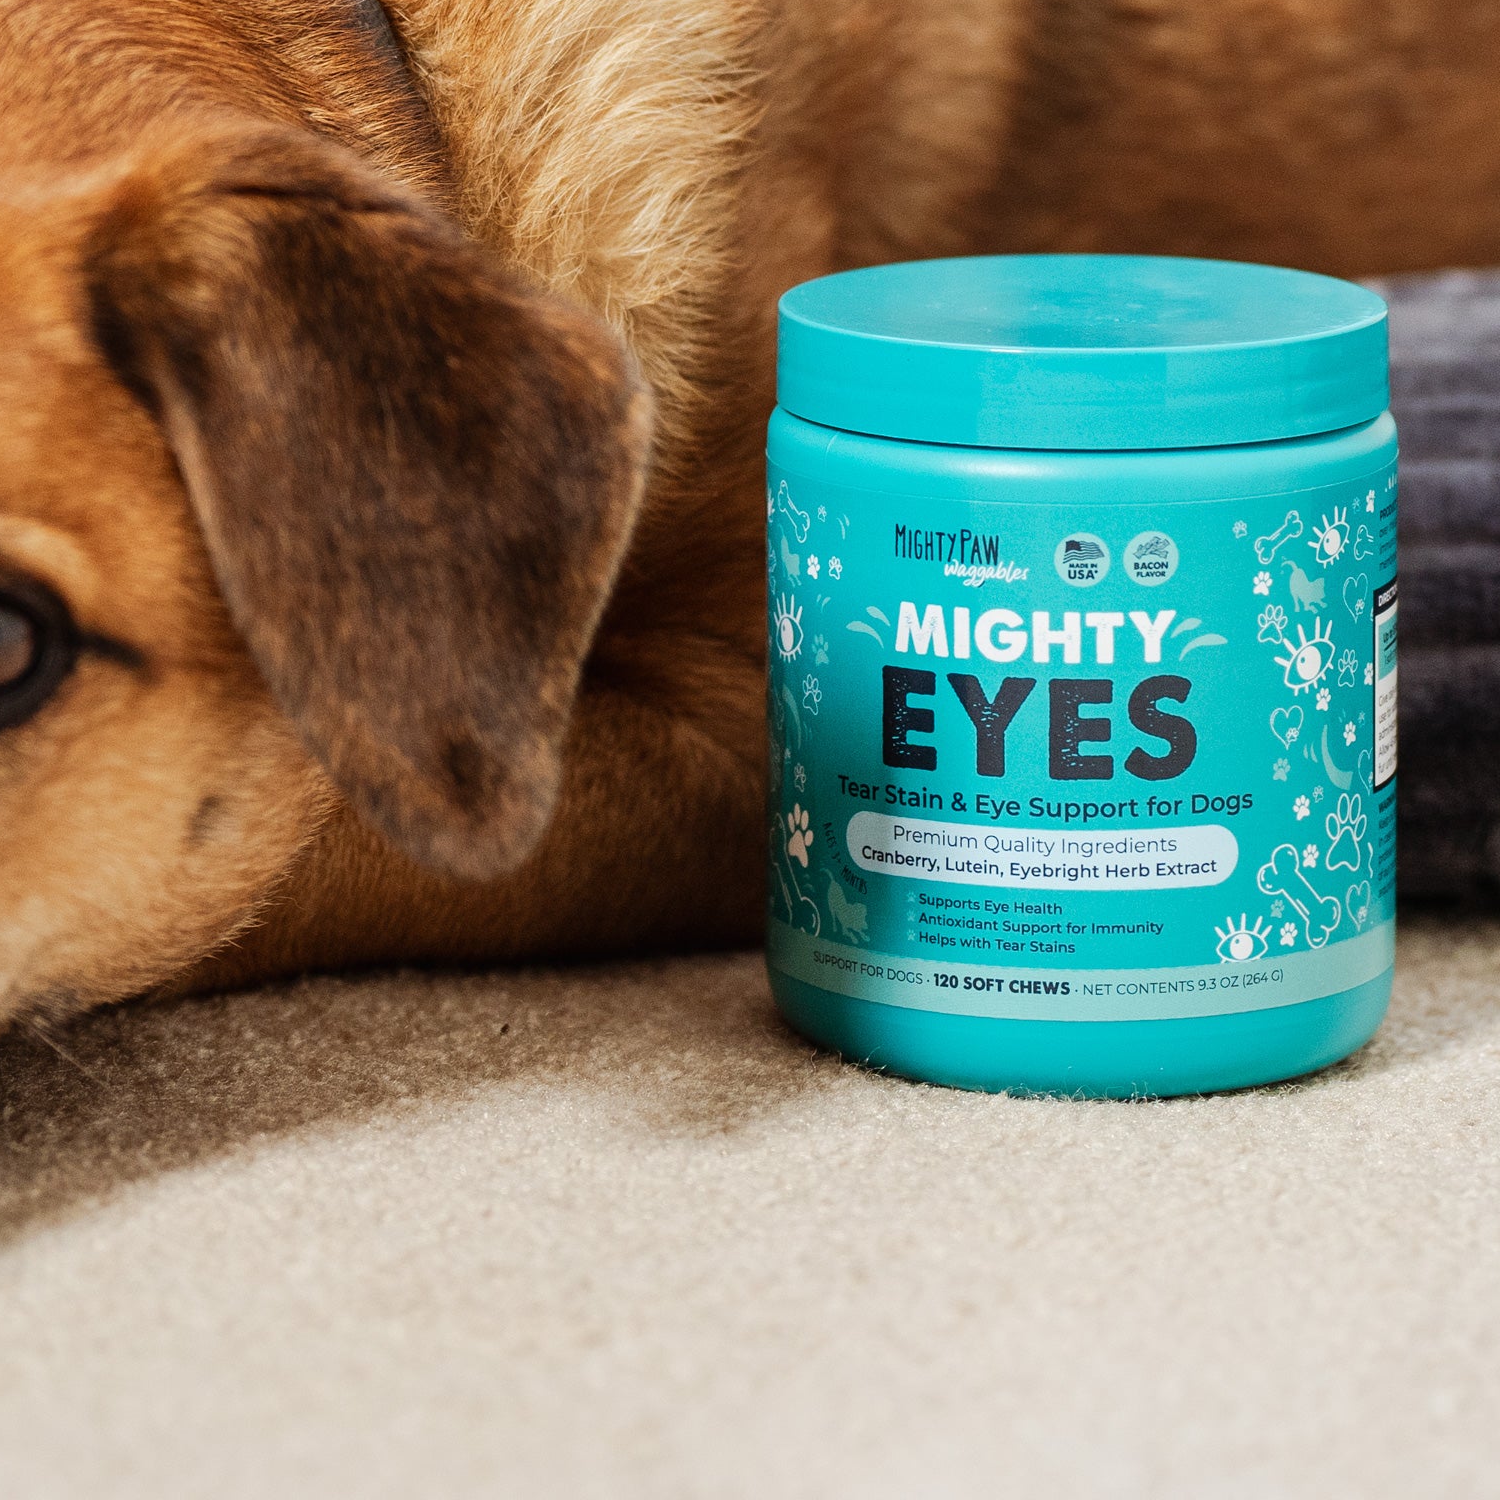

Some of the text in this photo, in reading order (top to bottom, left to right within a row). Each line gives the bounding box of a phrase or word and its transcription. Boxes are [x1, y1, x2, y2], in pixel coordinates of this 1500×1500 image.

[1134, 562, 1168, 570] BACON
[895, 601, 1177, 664] MIGHTY
[882, 664, 1197, 781] EYES
[838, 775, 1253, 822] Tear Stain & Eye Support for Dogs
[893, 825, 1177, 857] Premium Quality Ingredients
[861, 846, 1217, 881] Cranberry, Lutein, Eyebright Herb Extract
[918, 893, 1062, 915] Supports Eye Health
[918, 912, 1164, 935] Antioxidant Support for Immunity
[919, 932, 1076, 953] Helps with Tear Stains
[813, 950, 1284, 996] SUPPORT FOR DOGS 120 SOFT CHEWS NET CONTENTS 9.3 OZ (264 G)
